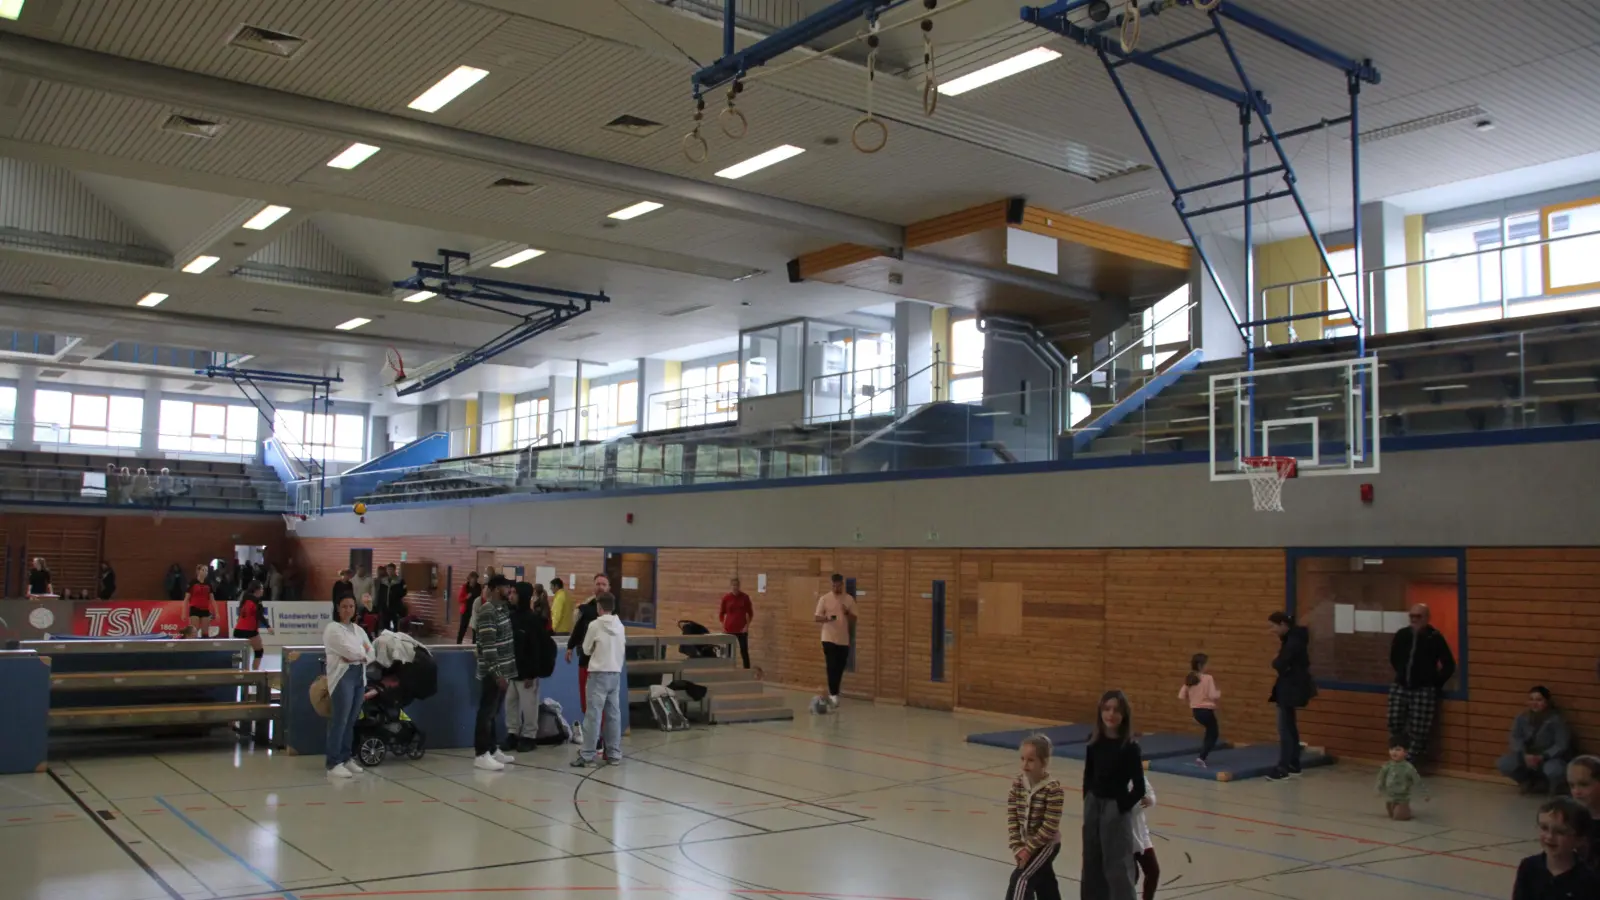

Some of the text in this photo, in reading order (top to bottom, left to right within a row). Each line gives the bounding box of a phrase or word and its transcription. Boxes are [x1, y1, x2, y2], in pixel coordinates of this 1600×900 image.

[85, 608, 162, 636] TSV
[279, 612, 330, 620] Handwerker für
